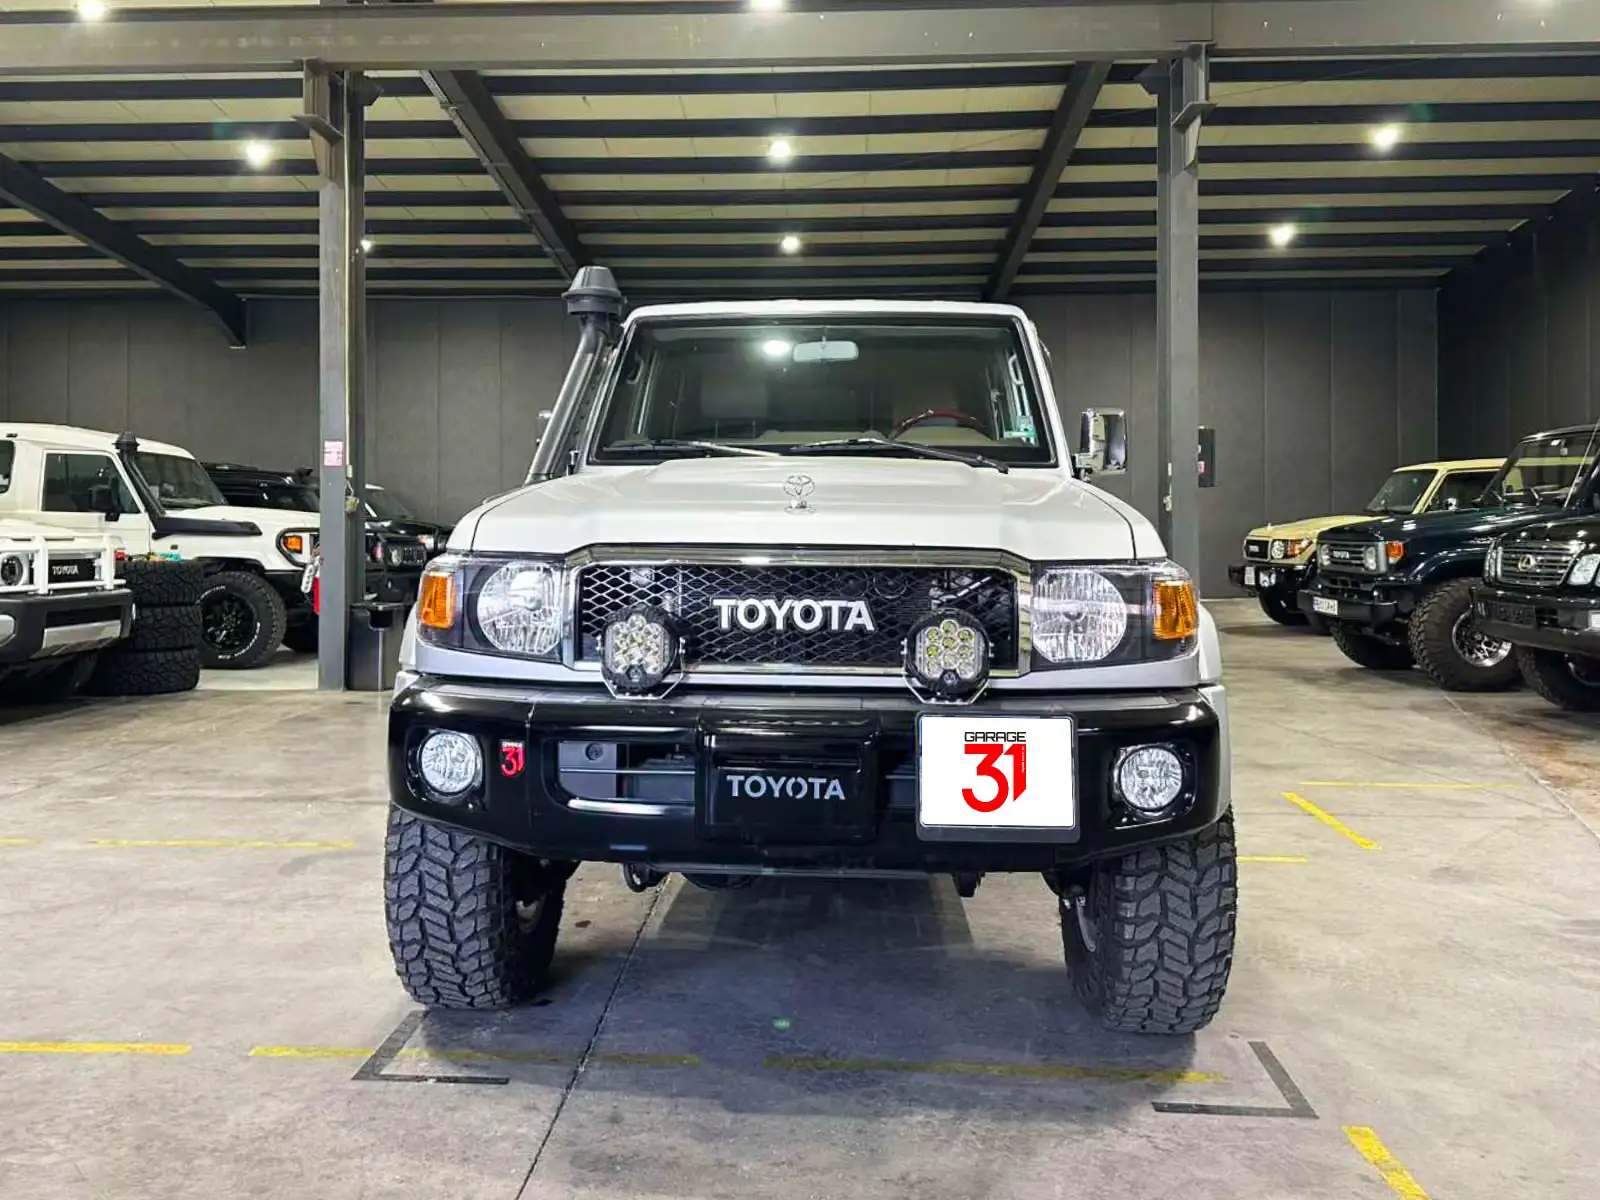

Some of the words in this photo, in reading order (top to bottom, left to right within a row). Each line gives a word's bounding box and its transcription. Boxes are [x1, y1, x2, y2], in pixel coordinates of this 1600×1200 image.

[712, 598, 875, 631] TOYOTA
[964, 731, 1027, 742] GARAGE
[501, 747, 525, 777] 31
[726, 774, 846, 801] TOYOTA
[961, 743, 1027, 812] 31
